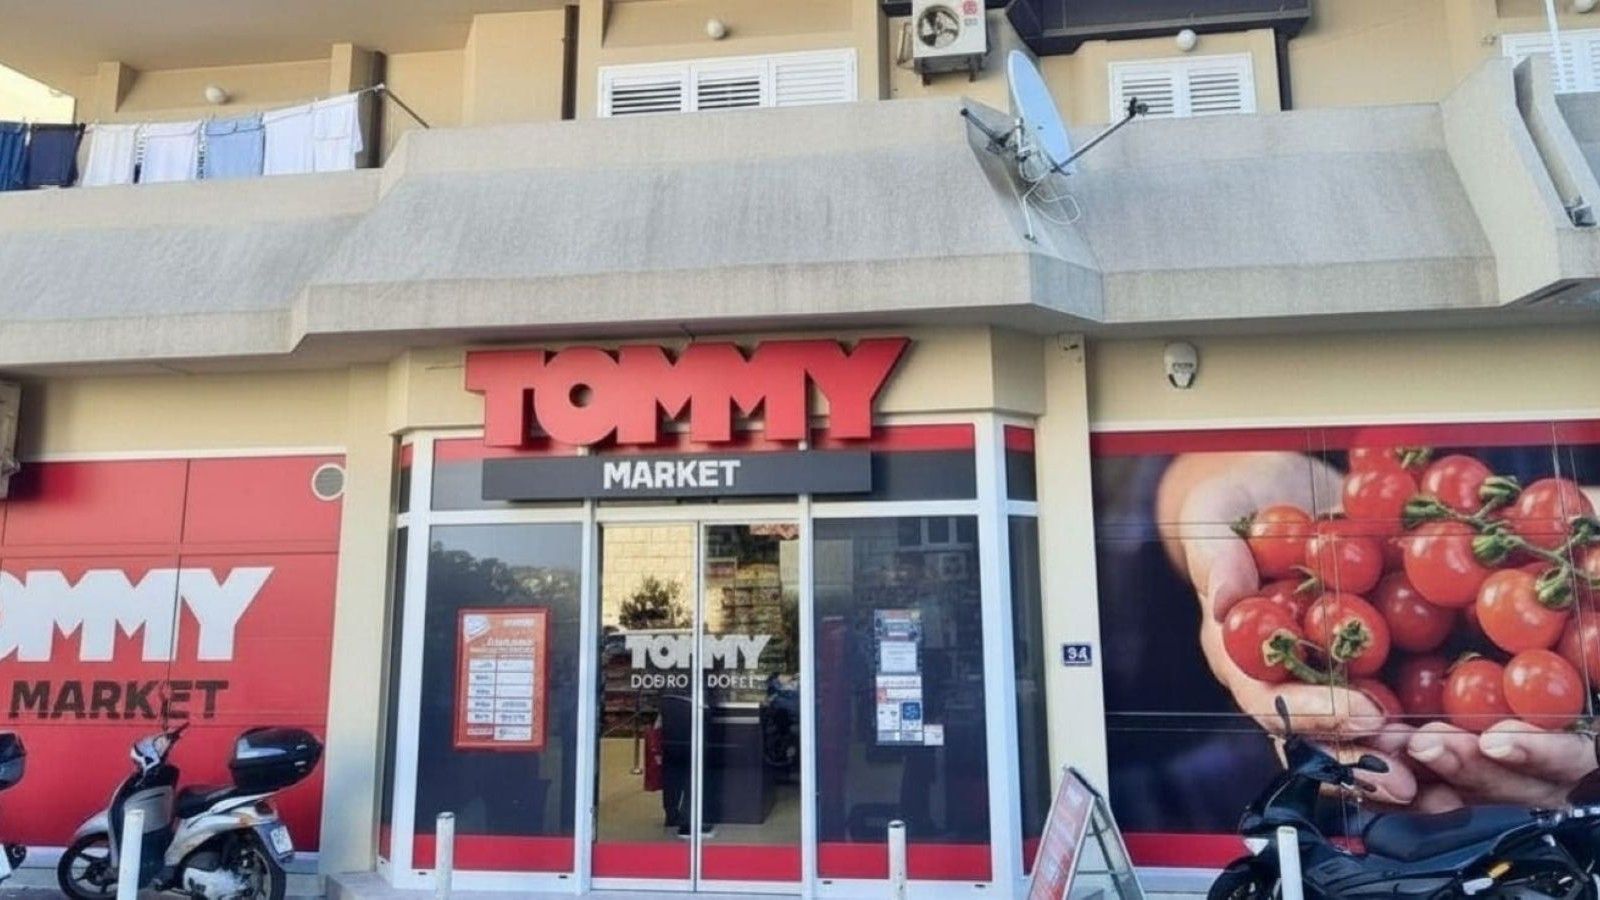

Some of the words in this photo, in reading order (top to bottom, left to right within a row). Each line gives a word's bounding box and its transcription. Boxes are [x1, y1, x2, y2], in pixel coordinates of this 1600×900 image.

[466, 337, 911, 447] TOMMY
[603, 459, 740, 489] MARKET
[9, 680, 229, 719] MARKET
